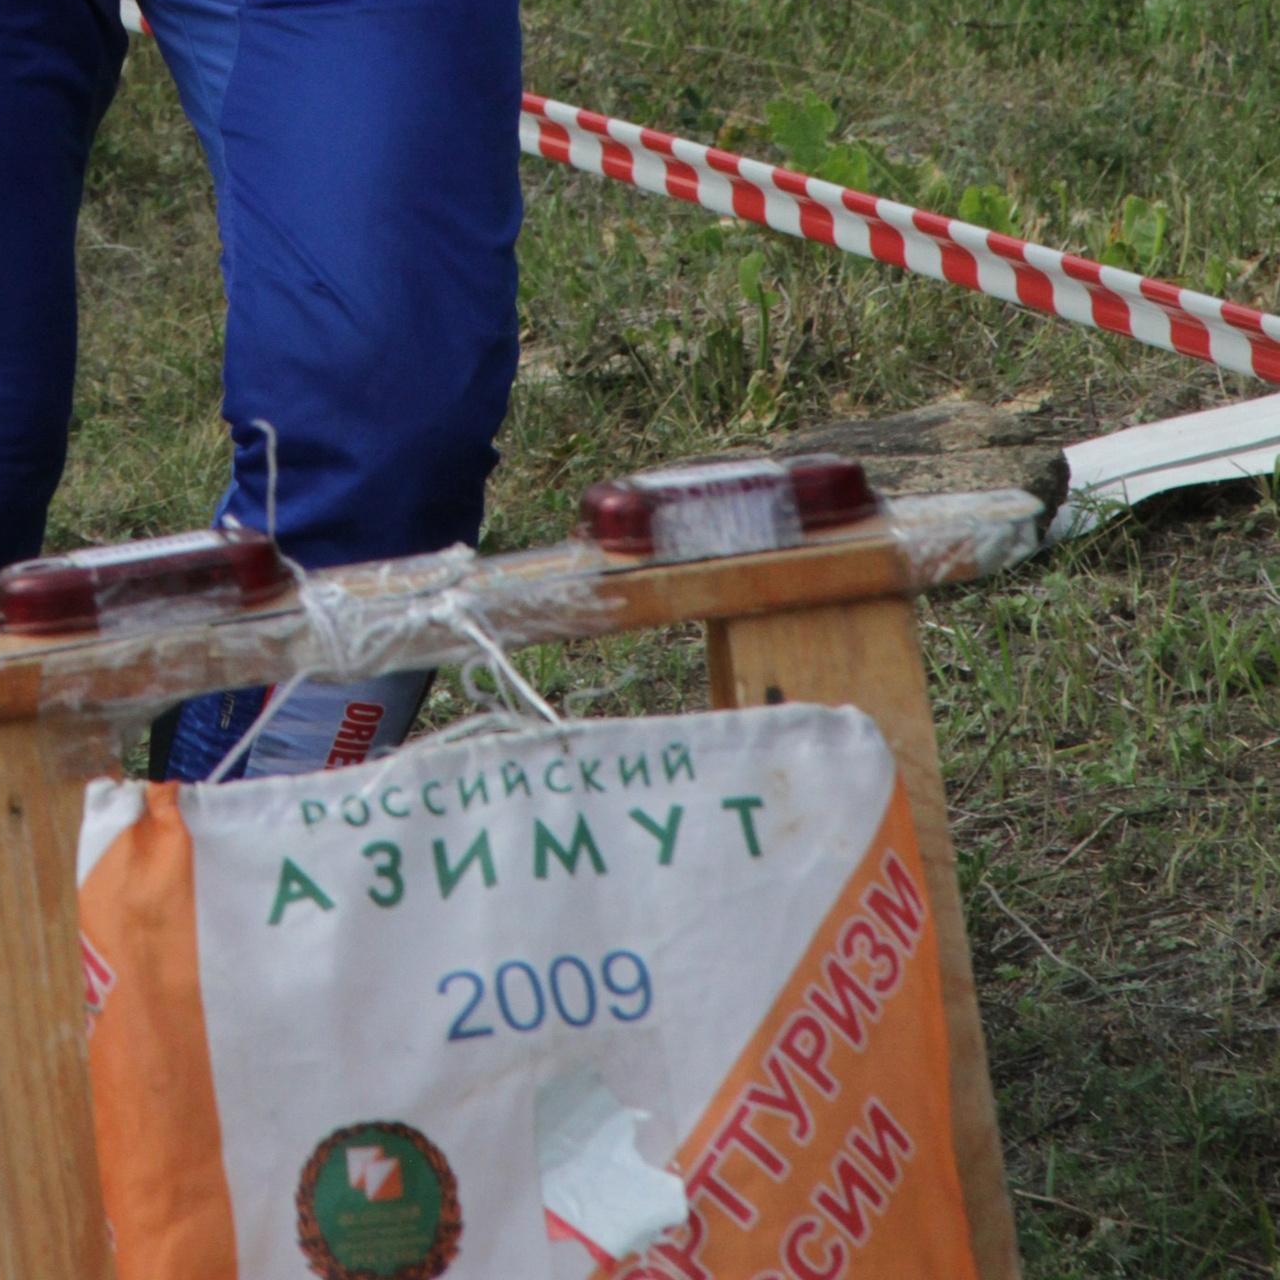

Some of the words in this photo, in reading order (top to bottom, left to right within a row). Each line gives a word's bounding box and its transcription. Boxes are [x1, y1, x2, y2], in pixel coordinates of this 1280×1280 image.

[324, 701, 385, 770] ORIE
[301, 742, 696, 831] РОССИЙСКИЙ
[268, 795, 765, 926] АЗИМУТ
[436, 949, 654, 1042] 2009
[756, 1100, 914, 1280] СИИ
